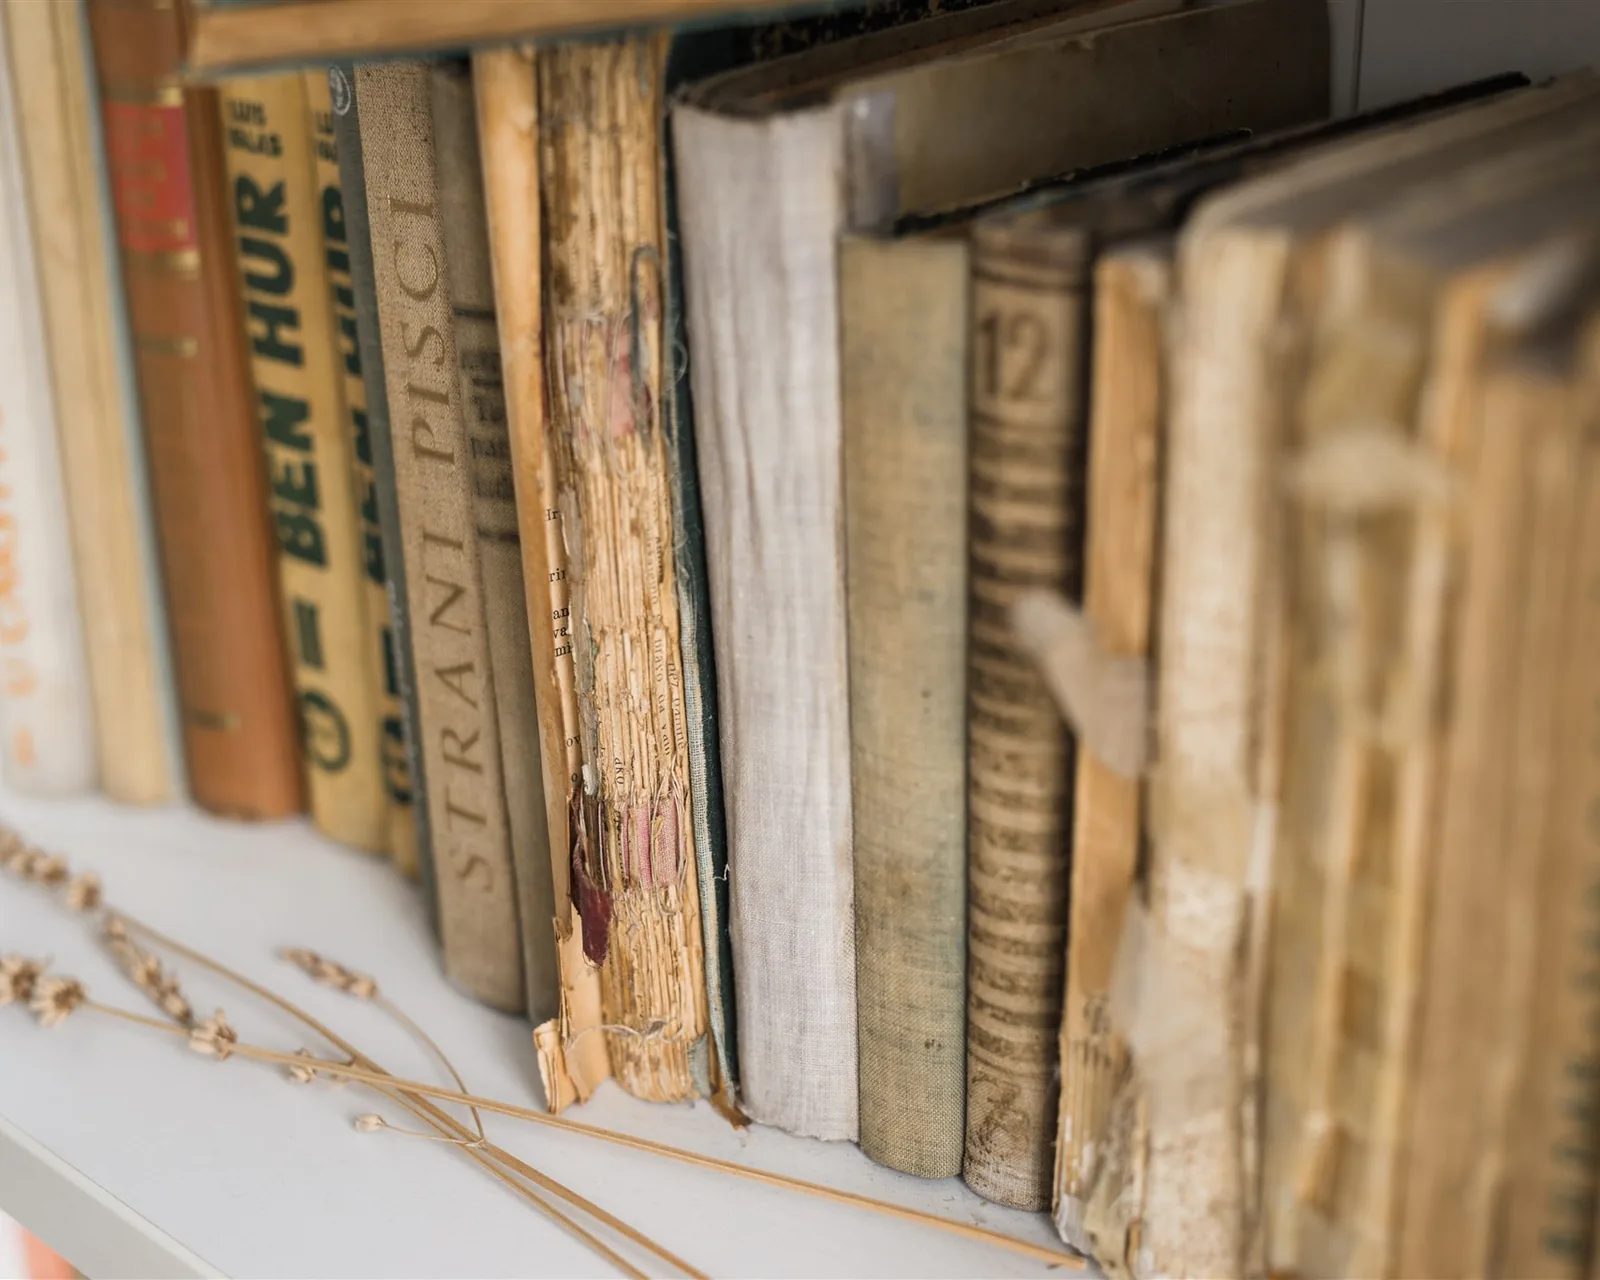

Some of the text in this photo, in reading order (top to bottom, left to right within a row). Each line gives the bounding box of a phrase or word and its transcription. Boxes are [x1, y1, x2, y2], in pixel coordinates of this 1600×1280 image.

[233, 175, 305, 368] HUR
[386, 197, 456, 467] PISCI
[980, 311, 1049, 401] 12
[258, 388, 329, 569] BEN
[421, 524, 495, 894] STRANI
